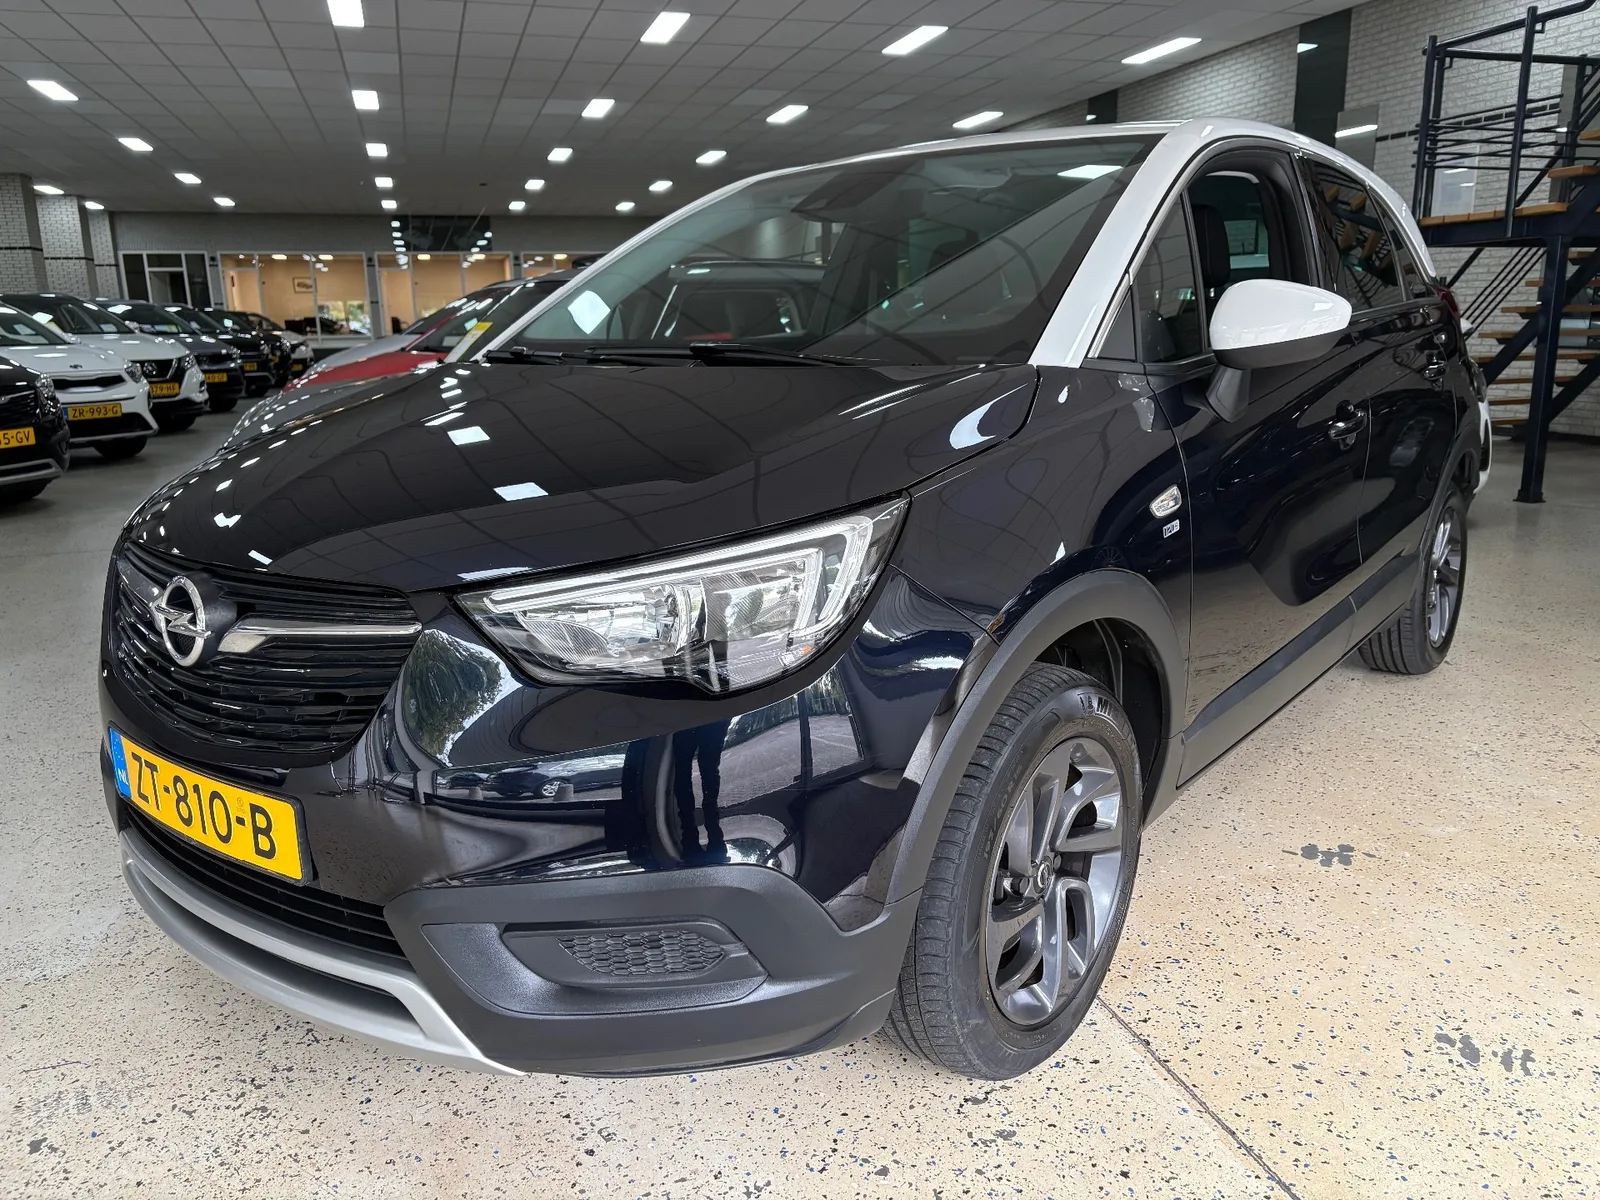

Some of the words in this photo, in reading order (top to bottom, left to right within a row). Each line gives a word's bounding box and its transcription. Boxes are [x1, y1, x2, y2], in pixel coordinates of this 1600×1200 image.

[72, 405, 118, 418] ZR-993-G
[0, 430, 30, 447] 5-GV
[117, 767, 130, 786] NL
[131, 752, 277, 860] ZT-810-B
